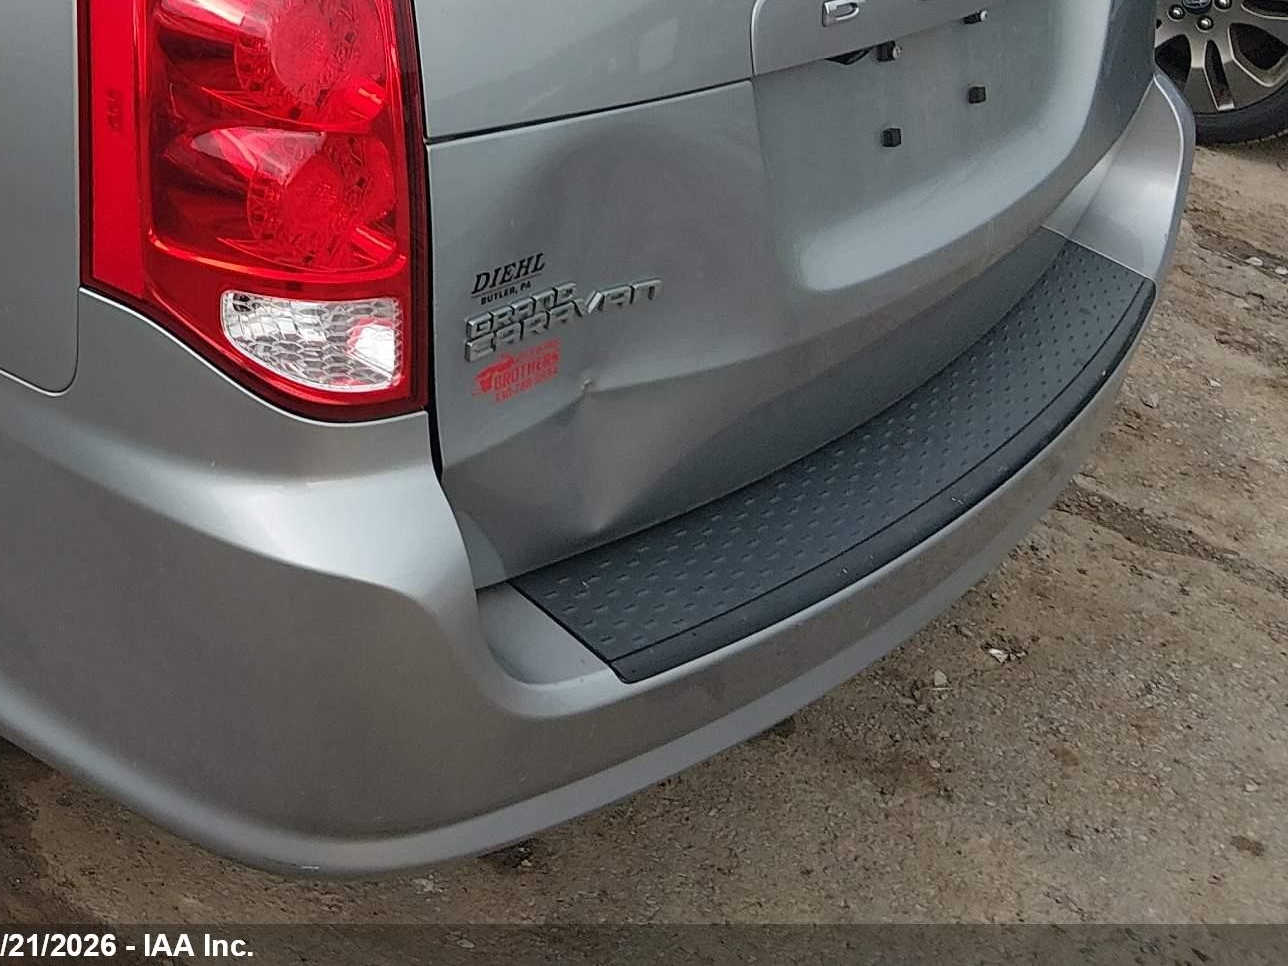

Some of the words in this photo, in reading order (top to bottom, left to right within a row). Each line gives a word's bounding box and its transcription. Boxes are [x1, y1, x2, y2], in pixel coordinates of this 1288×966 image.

[471, 252, 546, 294] DIEHL
[480, 288, 518, 305] BUTLER,
[520, 280, 531, 291] PA
[464, 277, 662, 363] CARAVAN
[465, 280, 577, 339] GRAND
